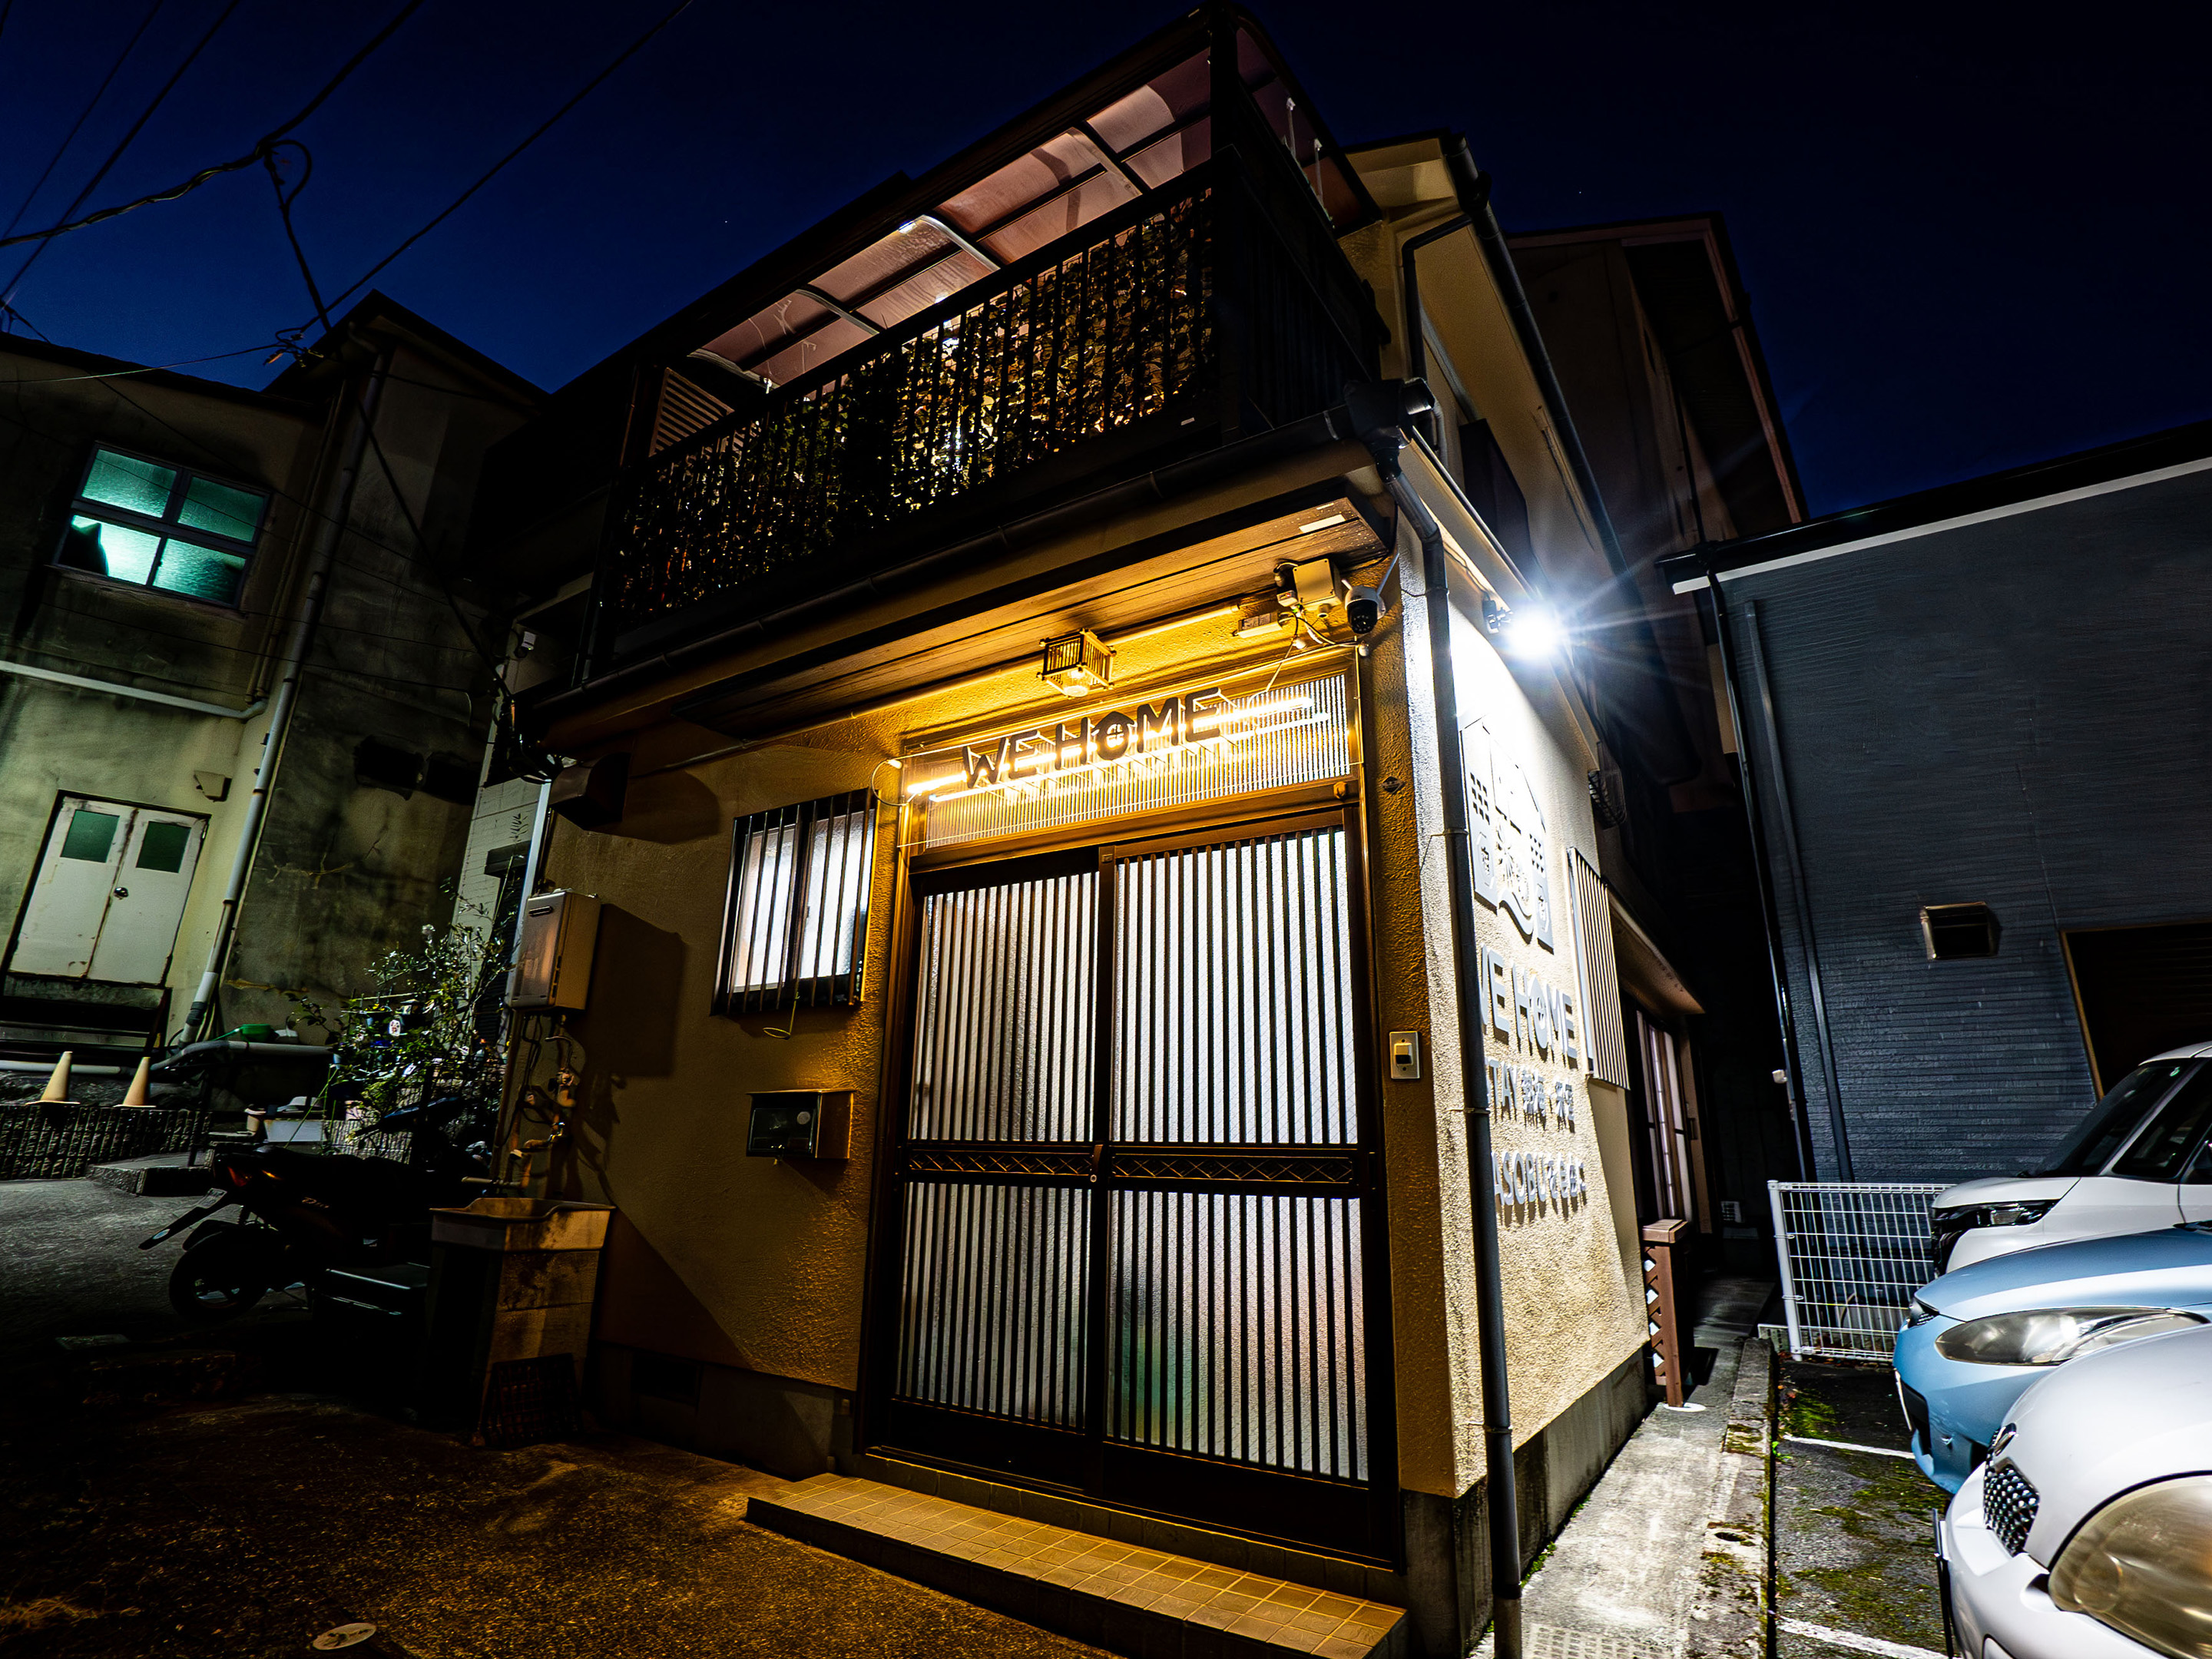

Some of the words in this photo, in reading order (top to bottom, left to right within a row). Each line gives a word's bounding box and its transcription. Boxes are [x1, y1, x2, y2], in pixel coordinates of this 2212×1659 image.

[962, 730, 1040, 790] WE
[1055, 687, 1222, 769] HOME
[1512, 962, 1578, 1058] HOME
